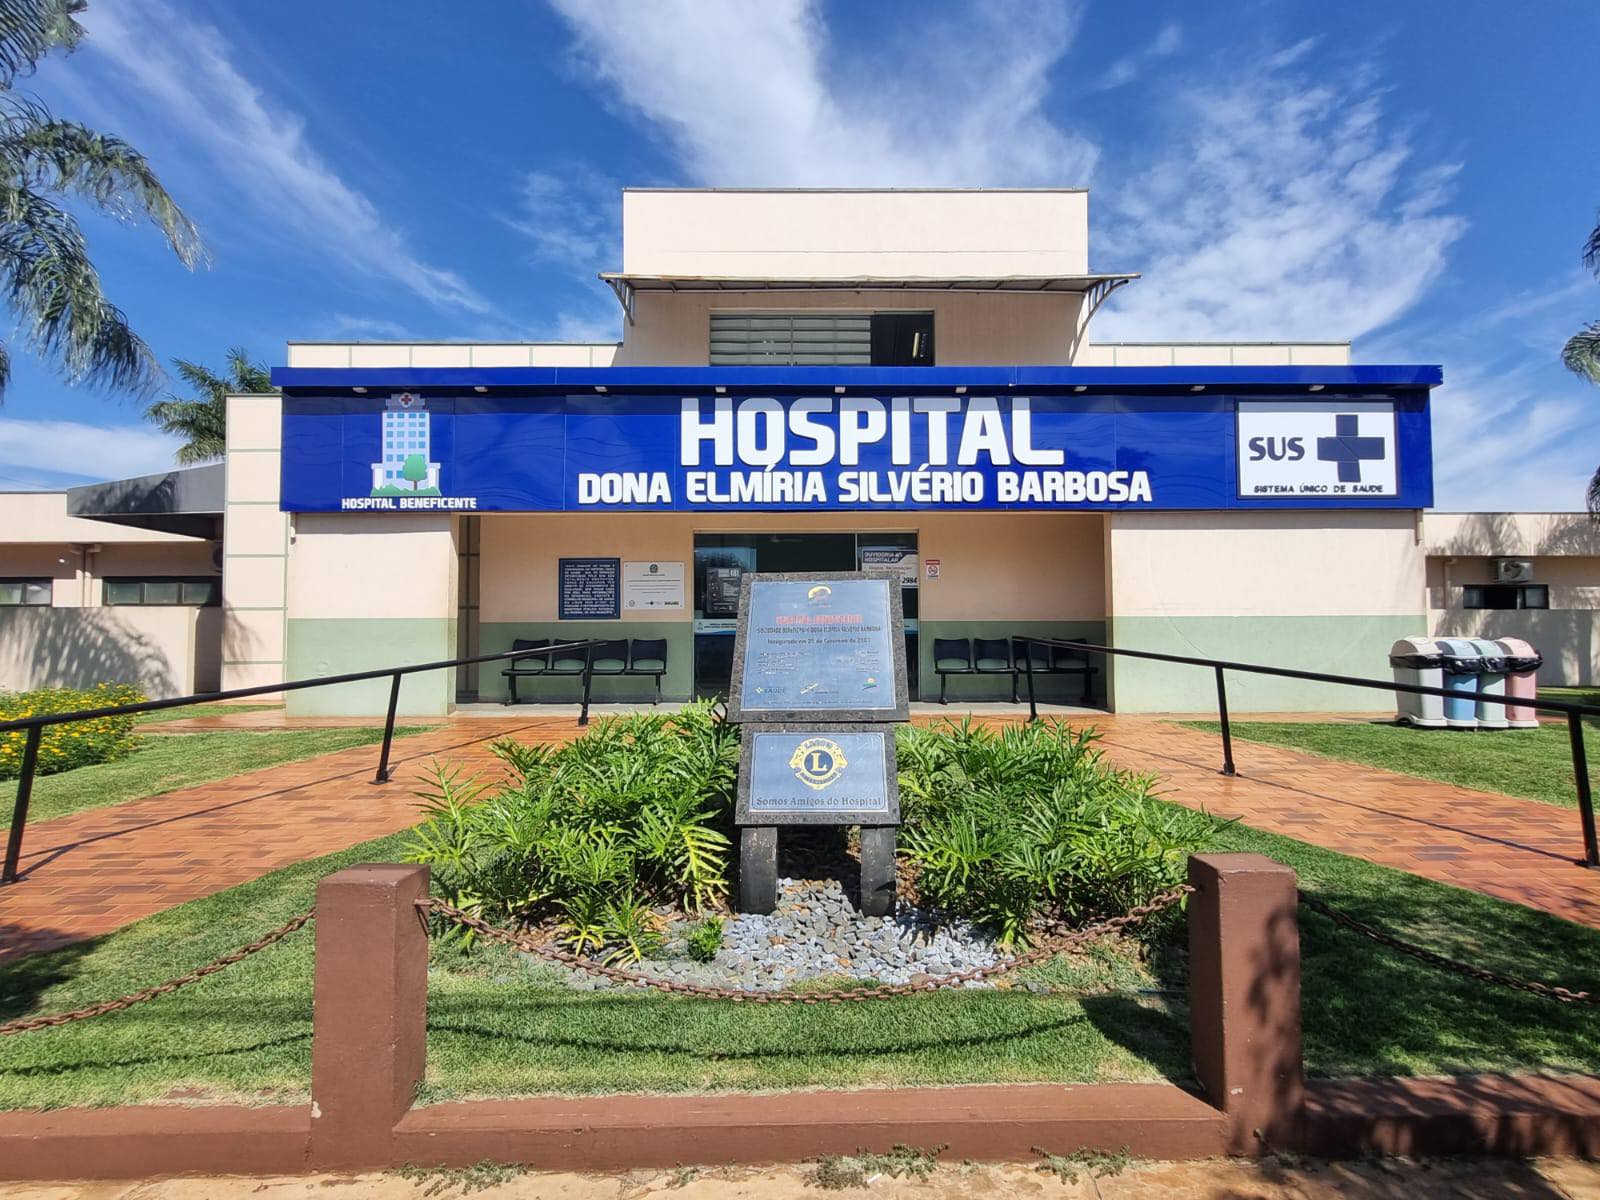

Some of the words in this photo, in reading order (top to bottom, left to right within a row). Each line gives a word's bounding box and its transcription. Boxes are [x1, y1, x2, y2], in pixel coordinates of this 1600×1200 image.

[680, 397, 1065, 467] HOSPITAL
[1248, 436, 1305, 461] SUS
[578, 472, 672, 504] DONA
[686, 463, 828, 503] ELMÍRIA
[837, 464, 984, 503] SILVÉRIO
[997, 471, 1153, 503] BARBOSA
[1253, 485, 1294, 493] SISTEMA
[1333, 485, 1346, 493] DE
[341, 497, 397, 509] HOSPITAL
[399, 497, 477, 509] BENEFICENTE
[810, 752, 828, 772] L
[756, 797, 788, 806] Somos
[790, 797, 825, 807] Amigos
[827, 797, 839, 806] do
[841, 797, 881, 807] Hospital
